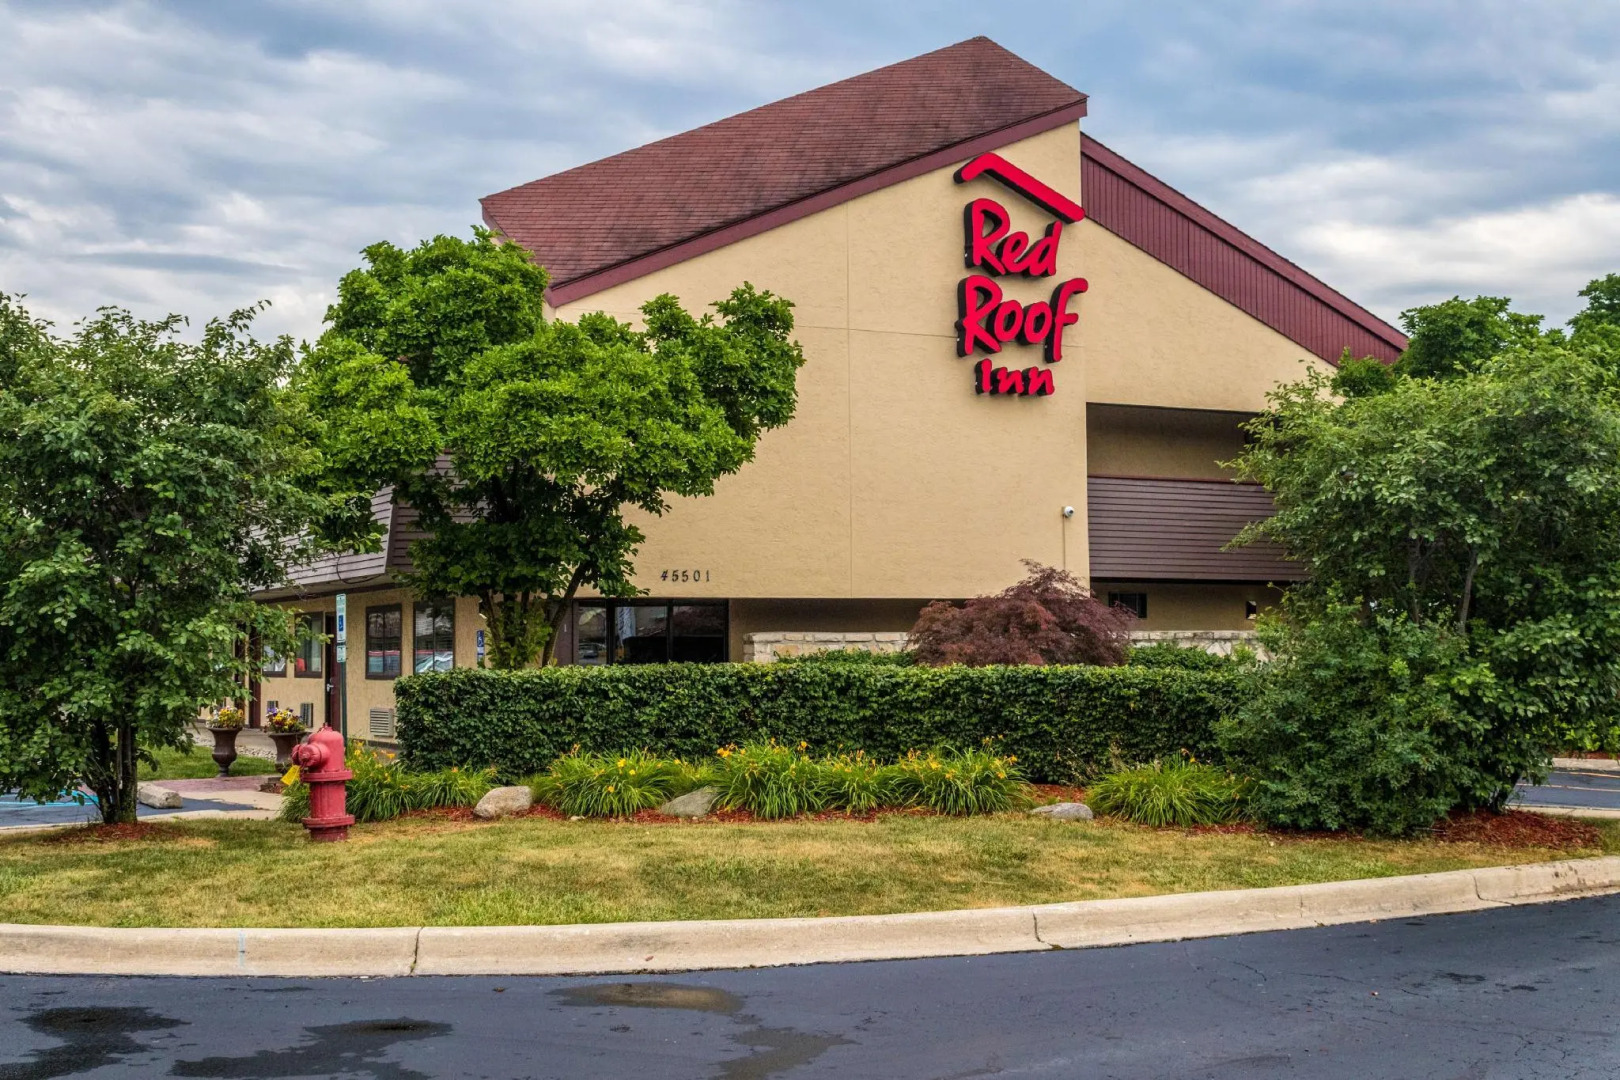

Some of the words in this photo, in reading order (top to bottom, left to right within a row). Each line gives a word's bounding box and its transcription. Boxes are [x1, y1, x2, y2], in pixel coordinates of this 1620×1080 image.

[965, 198, 1062, 277] Red
[956, 275, 1089, 363] Roof
[976, 358, 1055, 395] Inn
[660, 569, 710, 582] 45501
